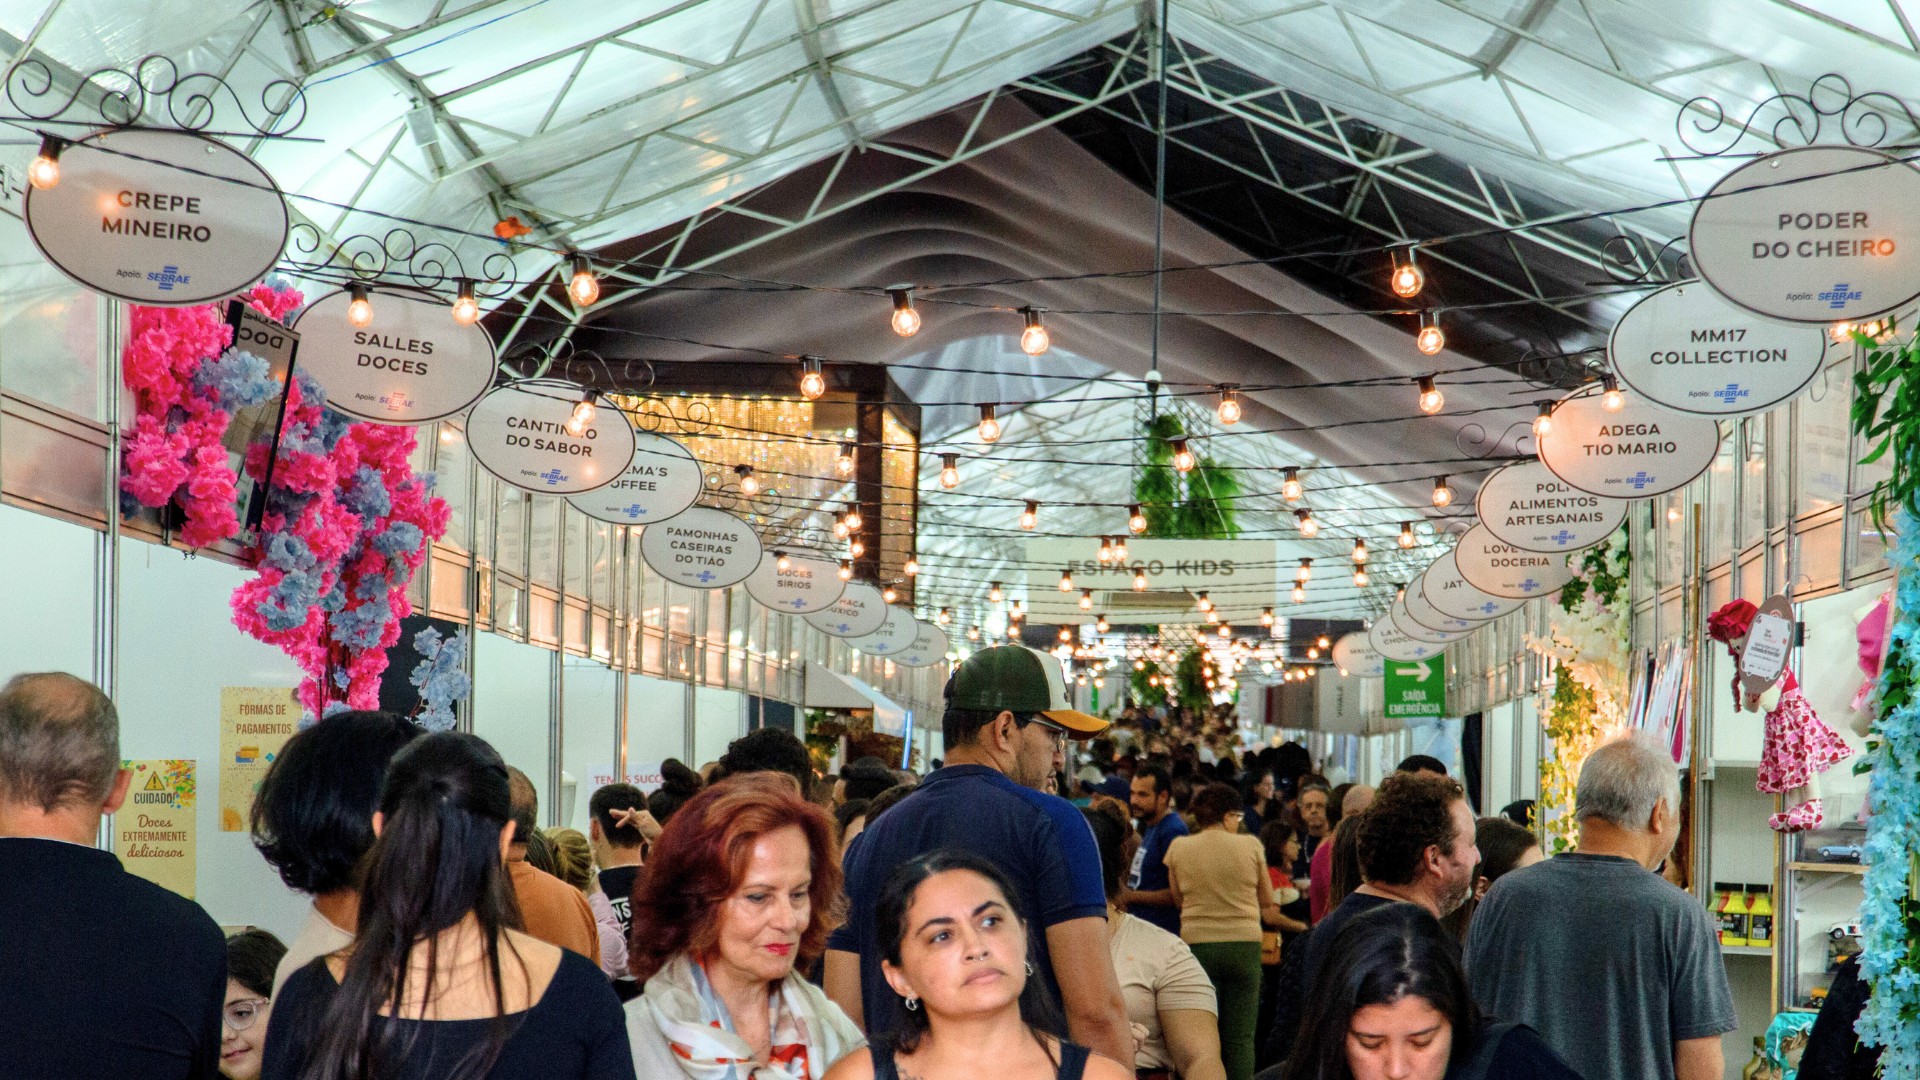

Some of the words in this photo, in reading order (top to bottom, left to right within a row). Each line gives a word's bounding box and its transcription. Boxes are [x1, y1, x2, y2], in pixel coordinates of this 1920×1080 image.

[117, 190, 201, 214] CREPE
[1778, 211, 1869, 230] PODER
[102, 216, 211, 243] MINEIRO
[1752, 241, 1790, 259] DO
[1796, 239, 1896, 258] CHEIRO
[147, 272, 191, 284] SEBRAE
[1817, 291, 1863, 301] SEBRAE
[354, 331, 434, 355] SALLES
[1691, 329, 1747, 343] MM17
[1650, 349, 1787, 365] COLLECTION
[357, 353, 428, 376] DOCES
[1713, 389, 1750, 397] SEBRAE
[506, 416, 597, 440] CANTINO
[1598, 423, 1660, 437] ADEGA
[506, 434, 530, 447] DO
[534, 438, 592, 457] SABOR
[1583, 444, 1613, 456] TIO
[1617, 441, 1677, 455] MARIO
[610, 479, 657, 491] OFFEE
[1509, 496, 1598, 510] ALIMENTOS
[1505, 512, 1604, 526] ARTESANAIS
[666, 527, 738, 542] PAMONHAS
[670, 540, 732, 555] CASEIRAS
[1483, 545, 1519, 554] LOVE
[675, 554, 693, 563] DO
[1491, 557, 1551, 567] DOCERIA
[1176, 559, 1235, 577] KIDS
[275, 704, 287, 715] DE
[236, 723, 292, 735] PAGAMENTOS
[594, 775, 632, 785] TEMS
[137, 814, 173, 828] Doces
[122, 831, 187, 842] EXTREMAMENTE
[127, 843, 185, 858] deliciosos
